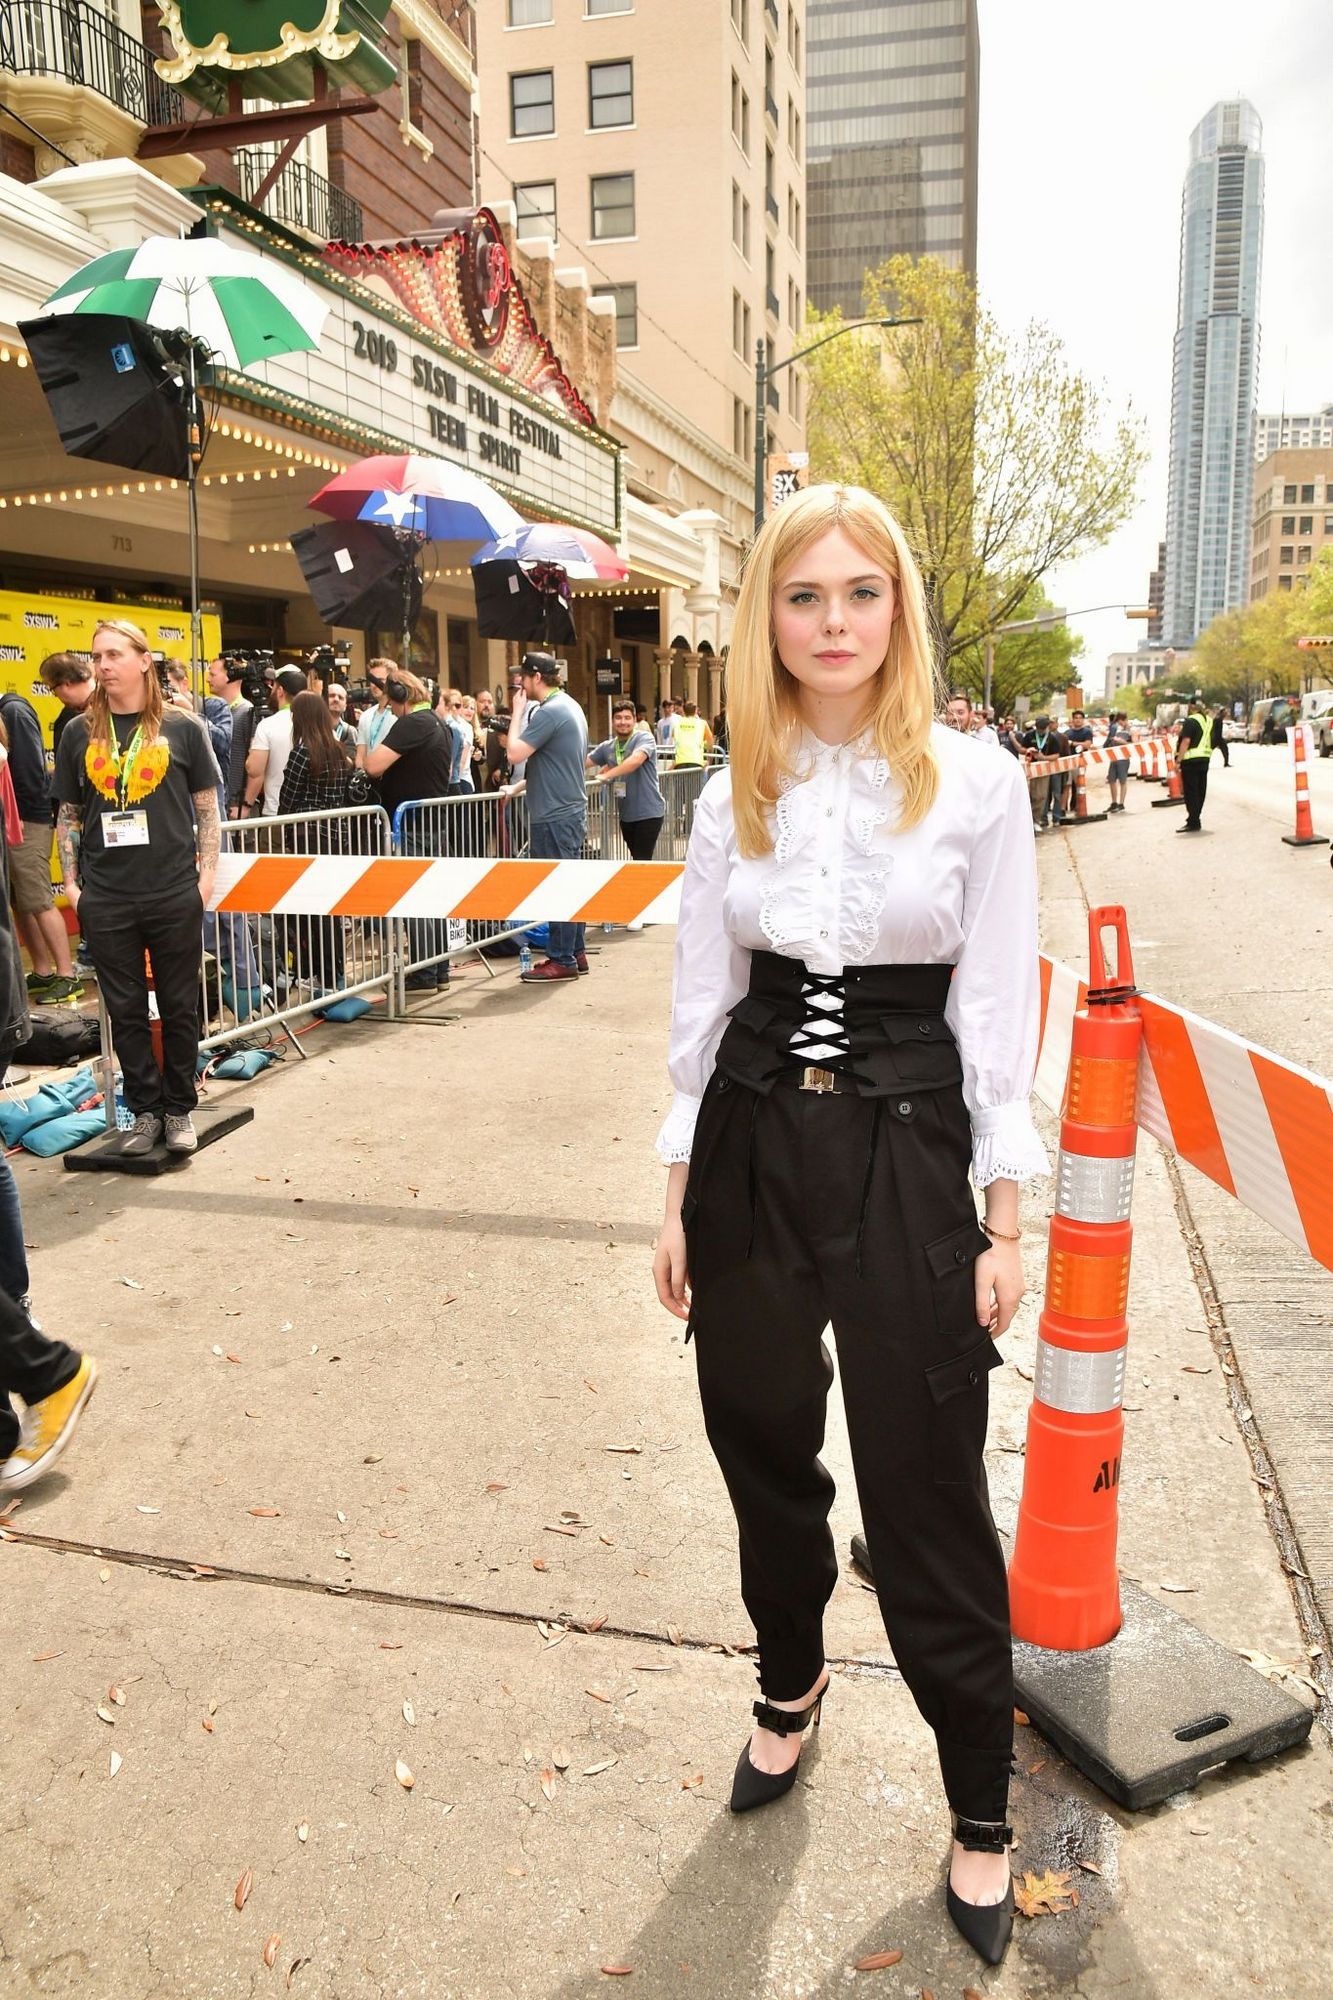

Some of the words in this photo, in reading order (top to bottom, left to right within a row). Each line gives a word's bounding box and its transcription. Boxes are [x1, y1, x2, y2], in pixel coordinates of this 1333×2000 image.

[353, 320, 398, 373] 2019
[412, 354, 458, 405] SXSW
[467, 383, 499, 428] FILM
[509, 407, 563, 461] FESTIVAL
[427, 404, 467, 451] TEEN
[479, 431, 522, 476] SPIRIT
[111, 534, 132, 552] 713
[23, 613, 57, 630] SXSW
[0, 647, 24, 662] SW
[449, 918, 460, 929] NO
